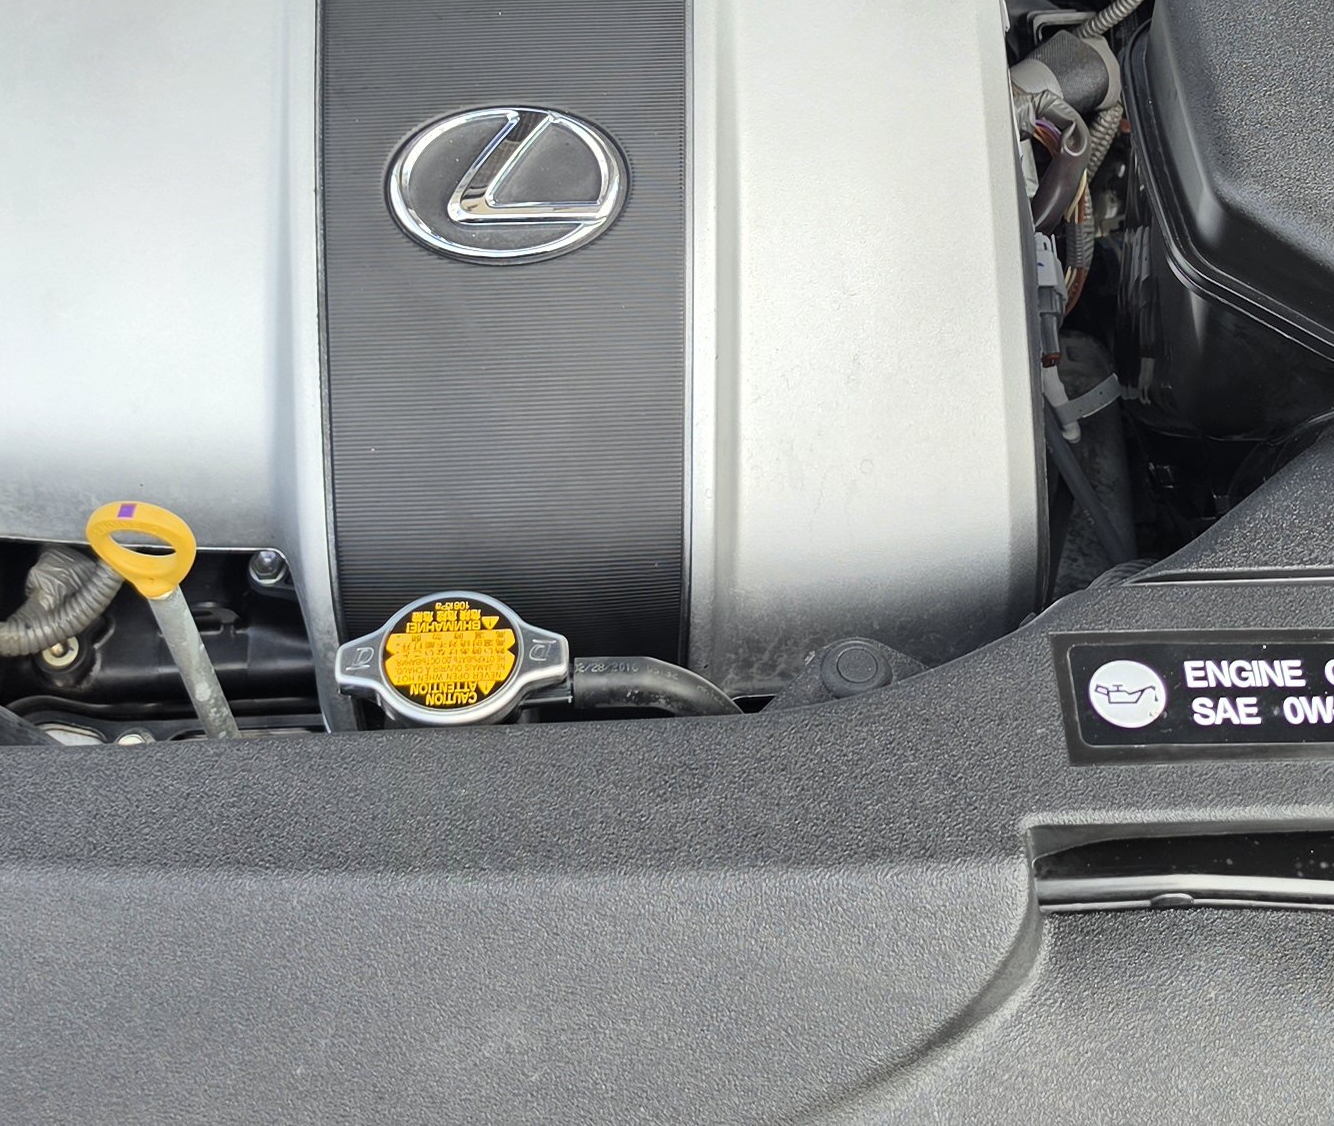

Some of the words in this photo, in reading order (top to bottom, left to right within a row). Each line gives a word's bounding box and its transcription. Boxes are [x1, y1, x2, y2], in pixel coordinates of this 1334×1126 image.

[406, 620, 481, 634] ВНИМАНИЕ!
[447, 672, 470, 680] OPEN
[473, 672, 501, 680] NEVER
[1183, 660, 1306, 688] ENGINE
[410, 682, 477, 695] ATTENTION
[426, 692, 477, 706] CAUTION
[1192, 696, 1262, 725] SAE
